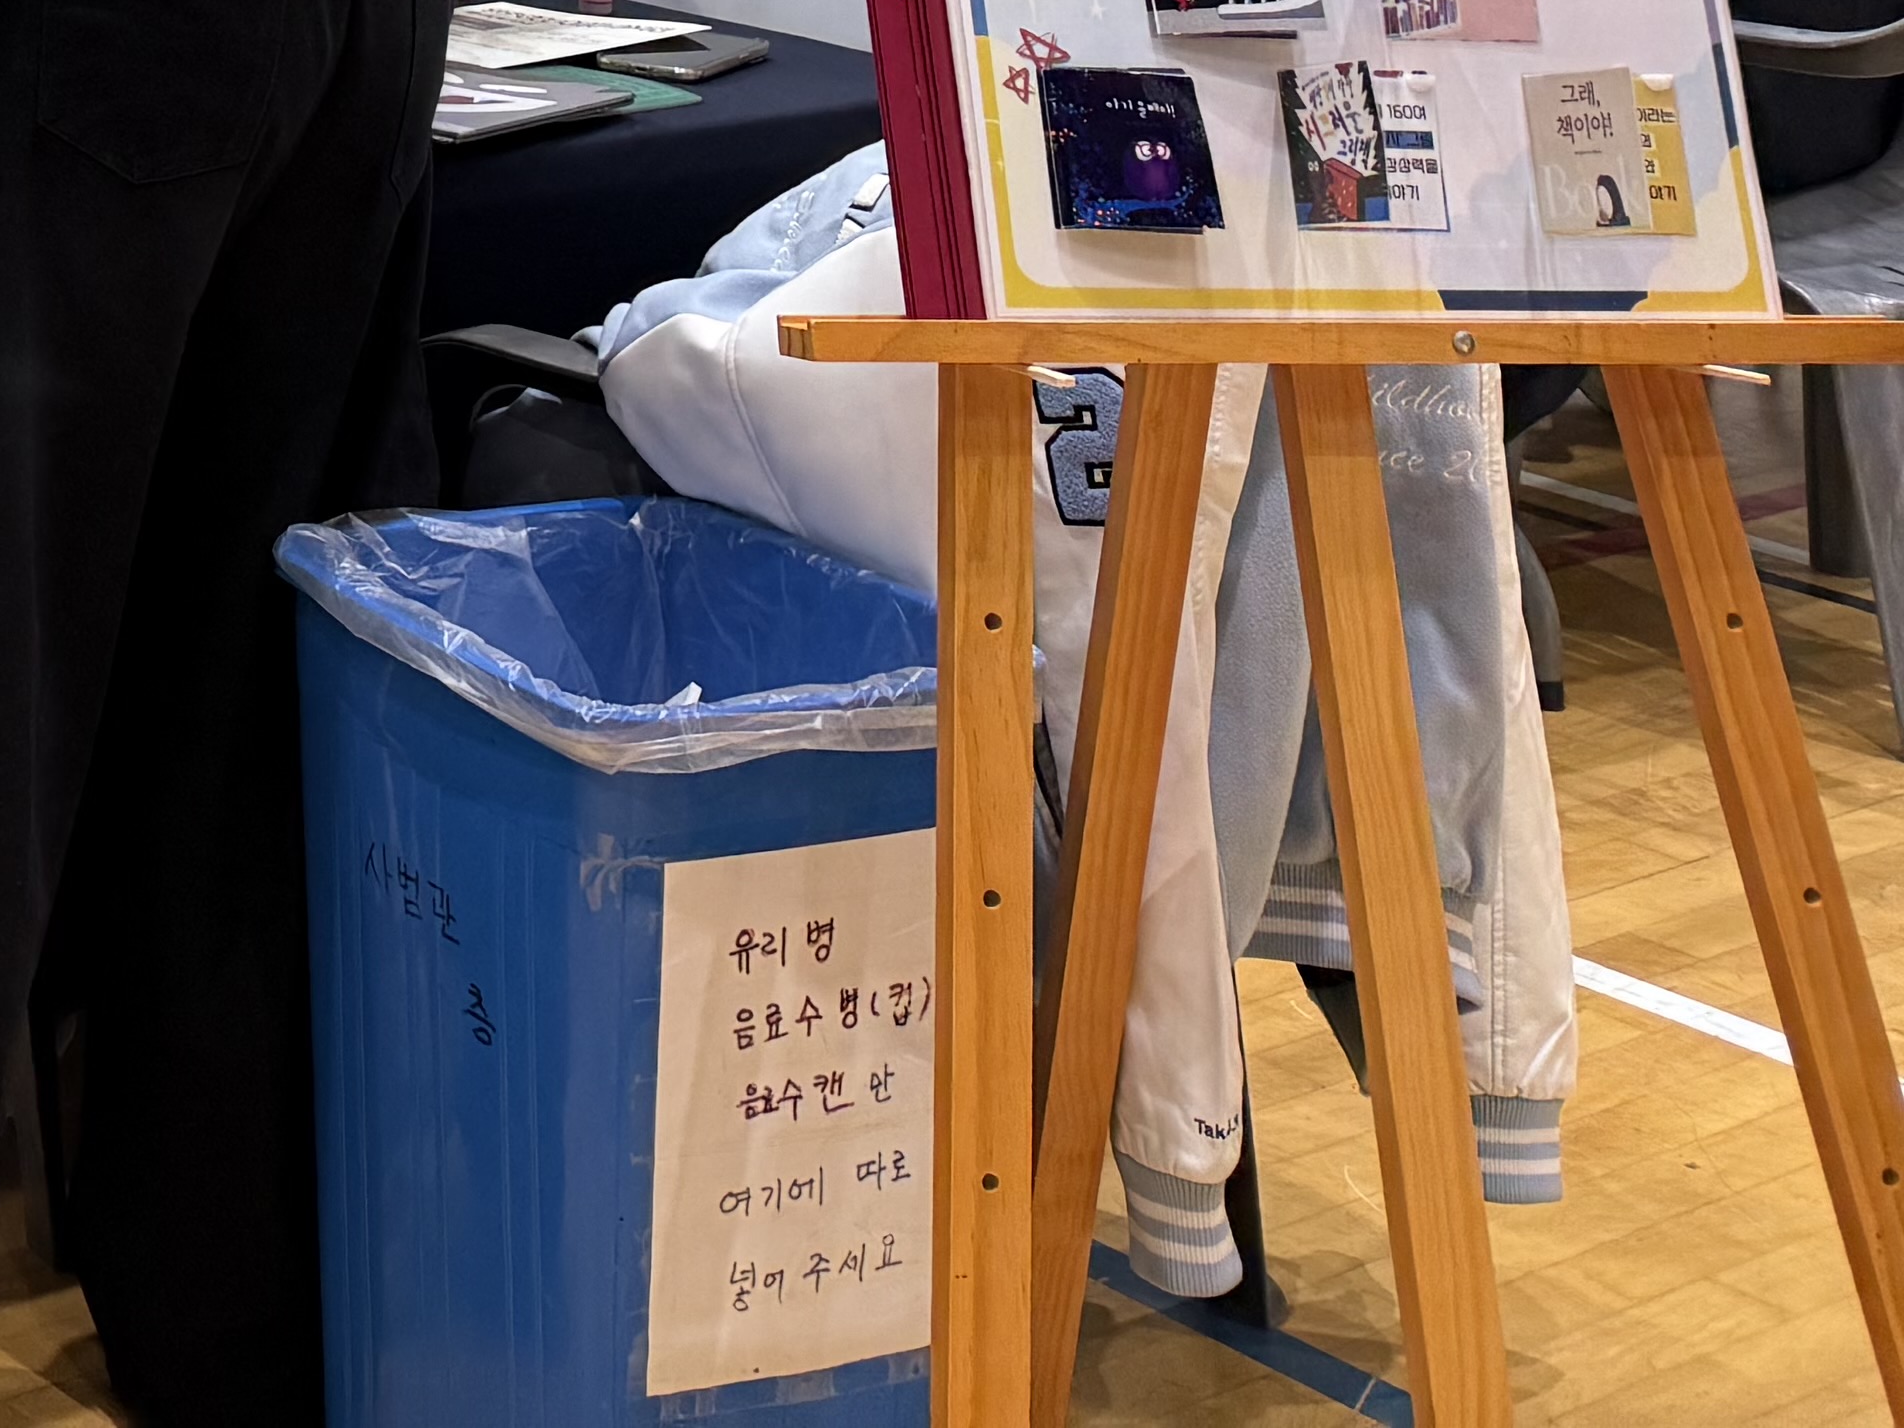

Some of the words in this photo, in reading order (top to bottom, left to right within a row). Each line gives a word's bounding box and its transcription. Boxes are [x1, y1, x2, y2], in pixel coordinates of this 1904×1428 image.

[1561, 80, 1600, 107] 그래,
[1556, 111, 1614, 145] 책이야!
[729, 927, 787, 975] 유리
[806, 917, 835, 962] 병
[733, 995, 824, 1050] 음료수
[719, 1166, 825, 1217] 여기에
[856, 1150, 912, 1192] 따로
[728, 1261, 785, 1312] 넣어
